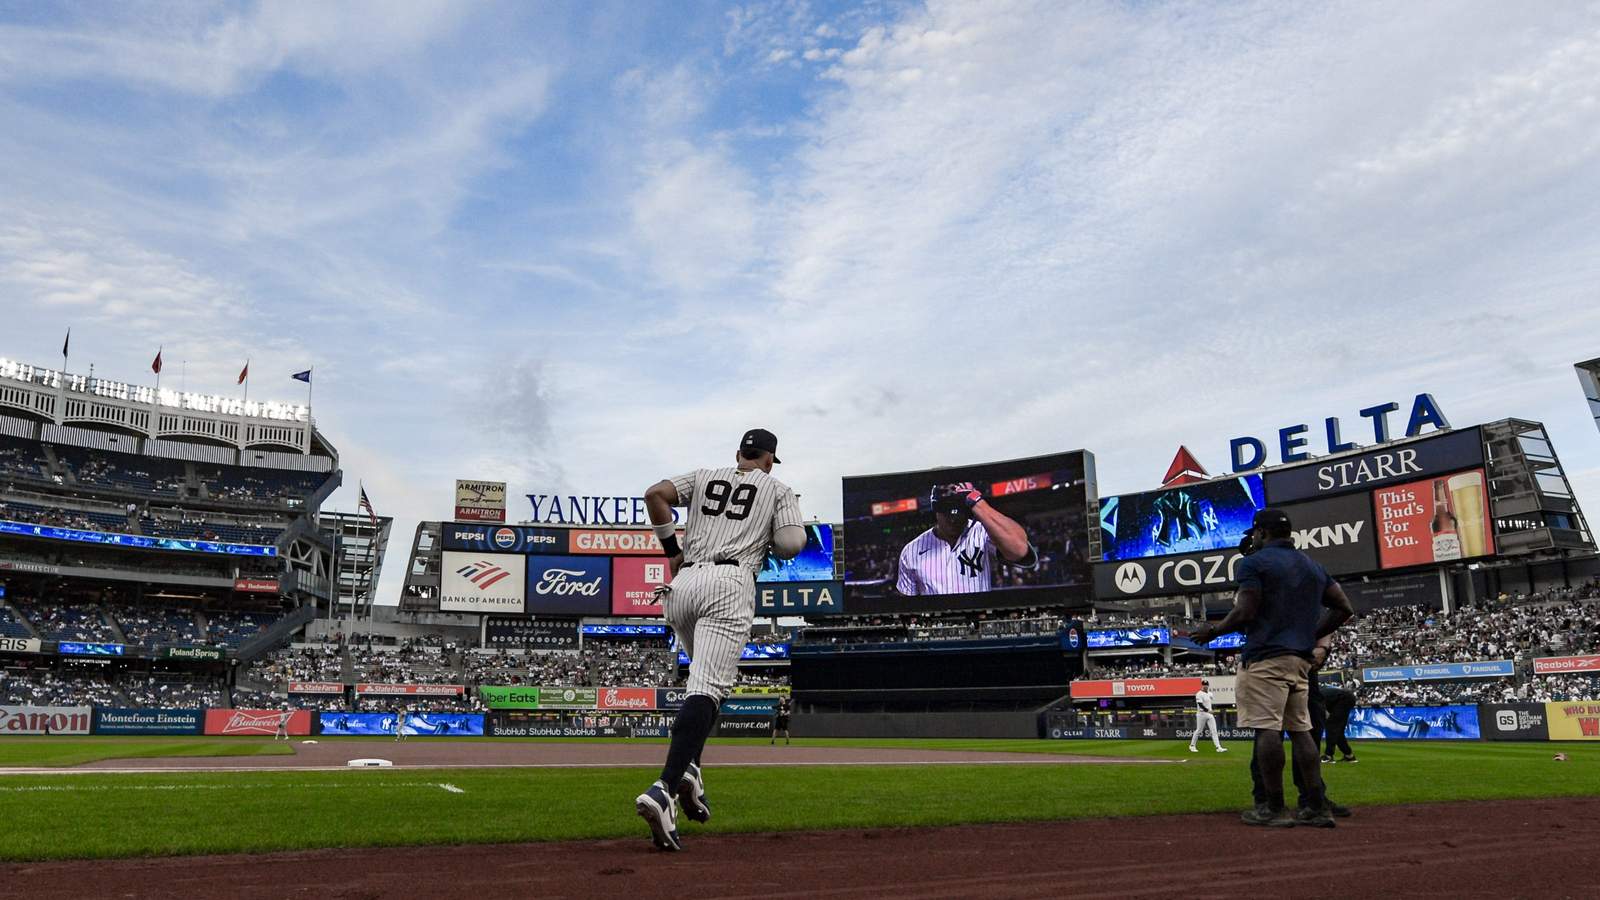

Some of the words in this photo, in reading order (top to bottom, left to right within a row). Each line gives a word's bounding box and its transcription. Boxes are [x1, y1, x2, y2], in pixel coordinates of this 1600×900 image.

[1230, 393, 1452, 473] DELTA
[1318, 448, 1424, 490] STARR
[458, 484, 504, 492] ARMITRON
[1004, 476, 1037, 494] AVIS
[701, 479, 758, 521] 99
[1379, 489, 1416, 506] This
[1382, 502, 1425, 520] Bud's
[1383, 521, 1409, 534] For
[455, 532, 484, 541] PEPSI
[526, 535, 556, 544] PEPSI
[576, 532, 684, 550] GATORA
[1384, 535, 1419, 549] You.
[1158, 553, 1245, 589] razr
[535, 568, 602, 596] Ford
[482, 597, 522, 605] AMERICA
[762, 588, 834, 607] ELTA
[169, 647, 195, 657] Poland
[195, 648, 220, 660] Spring
[1472, 665, 1502, 673] FANDUEL
[1536, 660, 1575, 670] Reebok
[1126, 684, 1156, 692] TOYOTA
[509, 692, 536, 703] Eats
[1563, 705, 1586, 716] WHO
[100, 713, 155, 723] Montefiore
[156, 714, 196, 723] Einstein
[231, 715, 279, 727] Budweise
[1499, 715, 1514, 726] GS
[494, 727, 526, 736] StubHub
[529, 727, 561, 736] StubHub
[564, 728, 596, 736] StubHub
[636, 728, 660, 736] STARR
[1095, 729, 1121, 738] STARR
[1176, 730, 1203, 738] StubHb
[1205, 730, 1230, 738] SHub
[1232, 730, 1256, 738] StubHu
